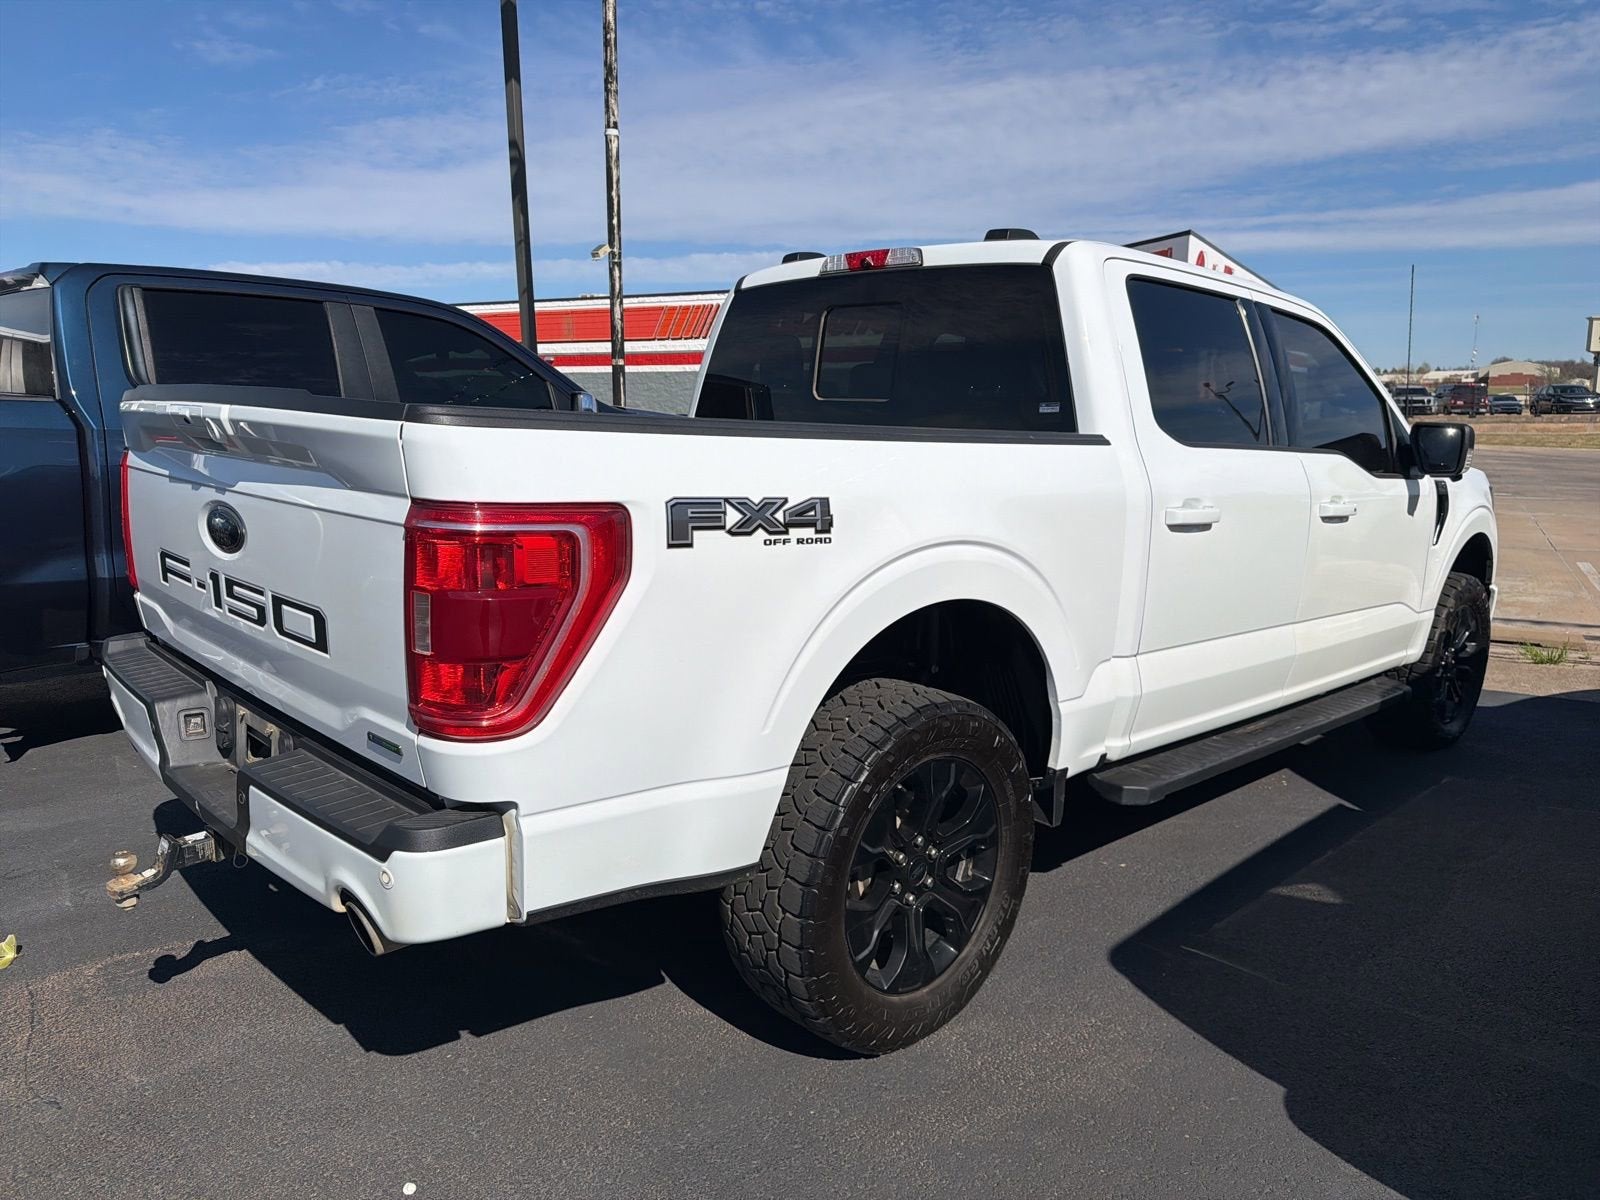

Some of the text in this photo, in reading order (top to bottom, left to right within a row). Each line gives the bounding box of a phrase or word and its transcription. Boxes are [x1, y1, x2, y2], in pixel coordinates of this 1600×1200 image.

[665, 497, 833, 548] FX4
[763, 537, 832, 546] OFF ROAD
[158, 547, 330, 657] F-150
